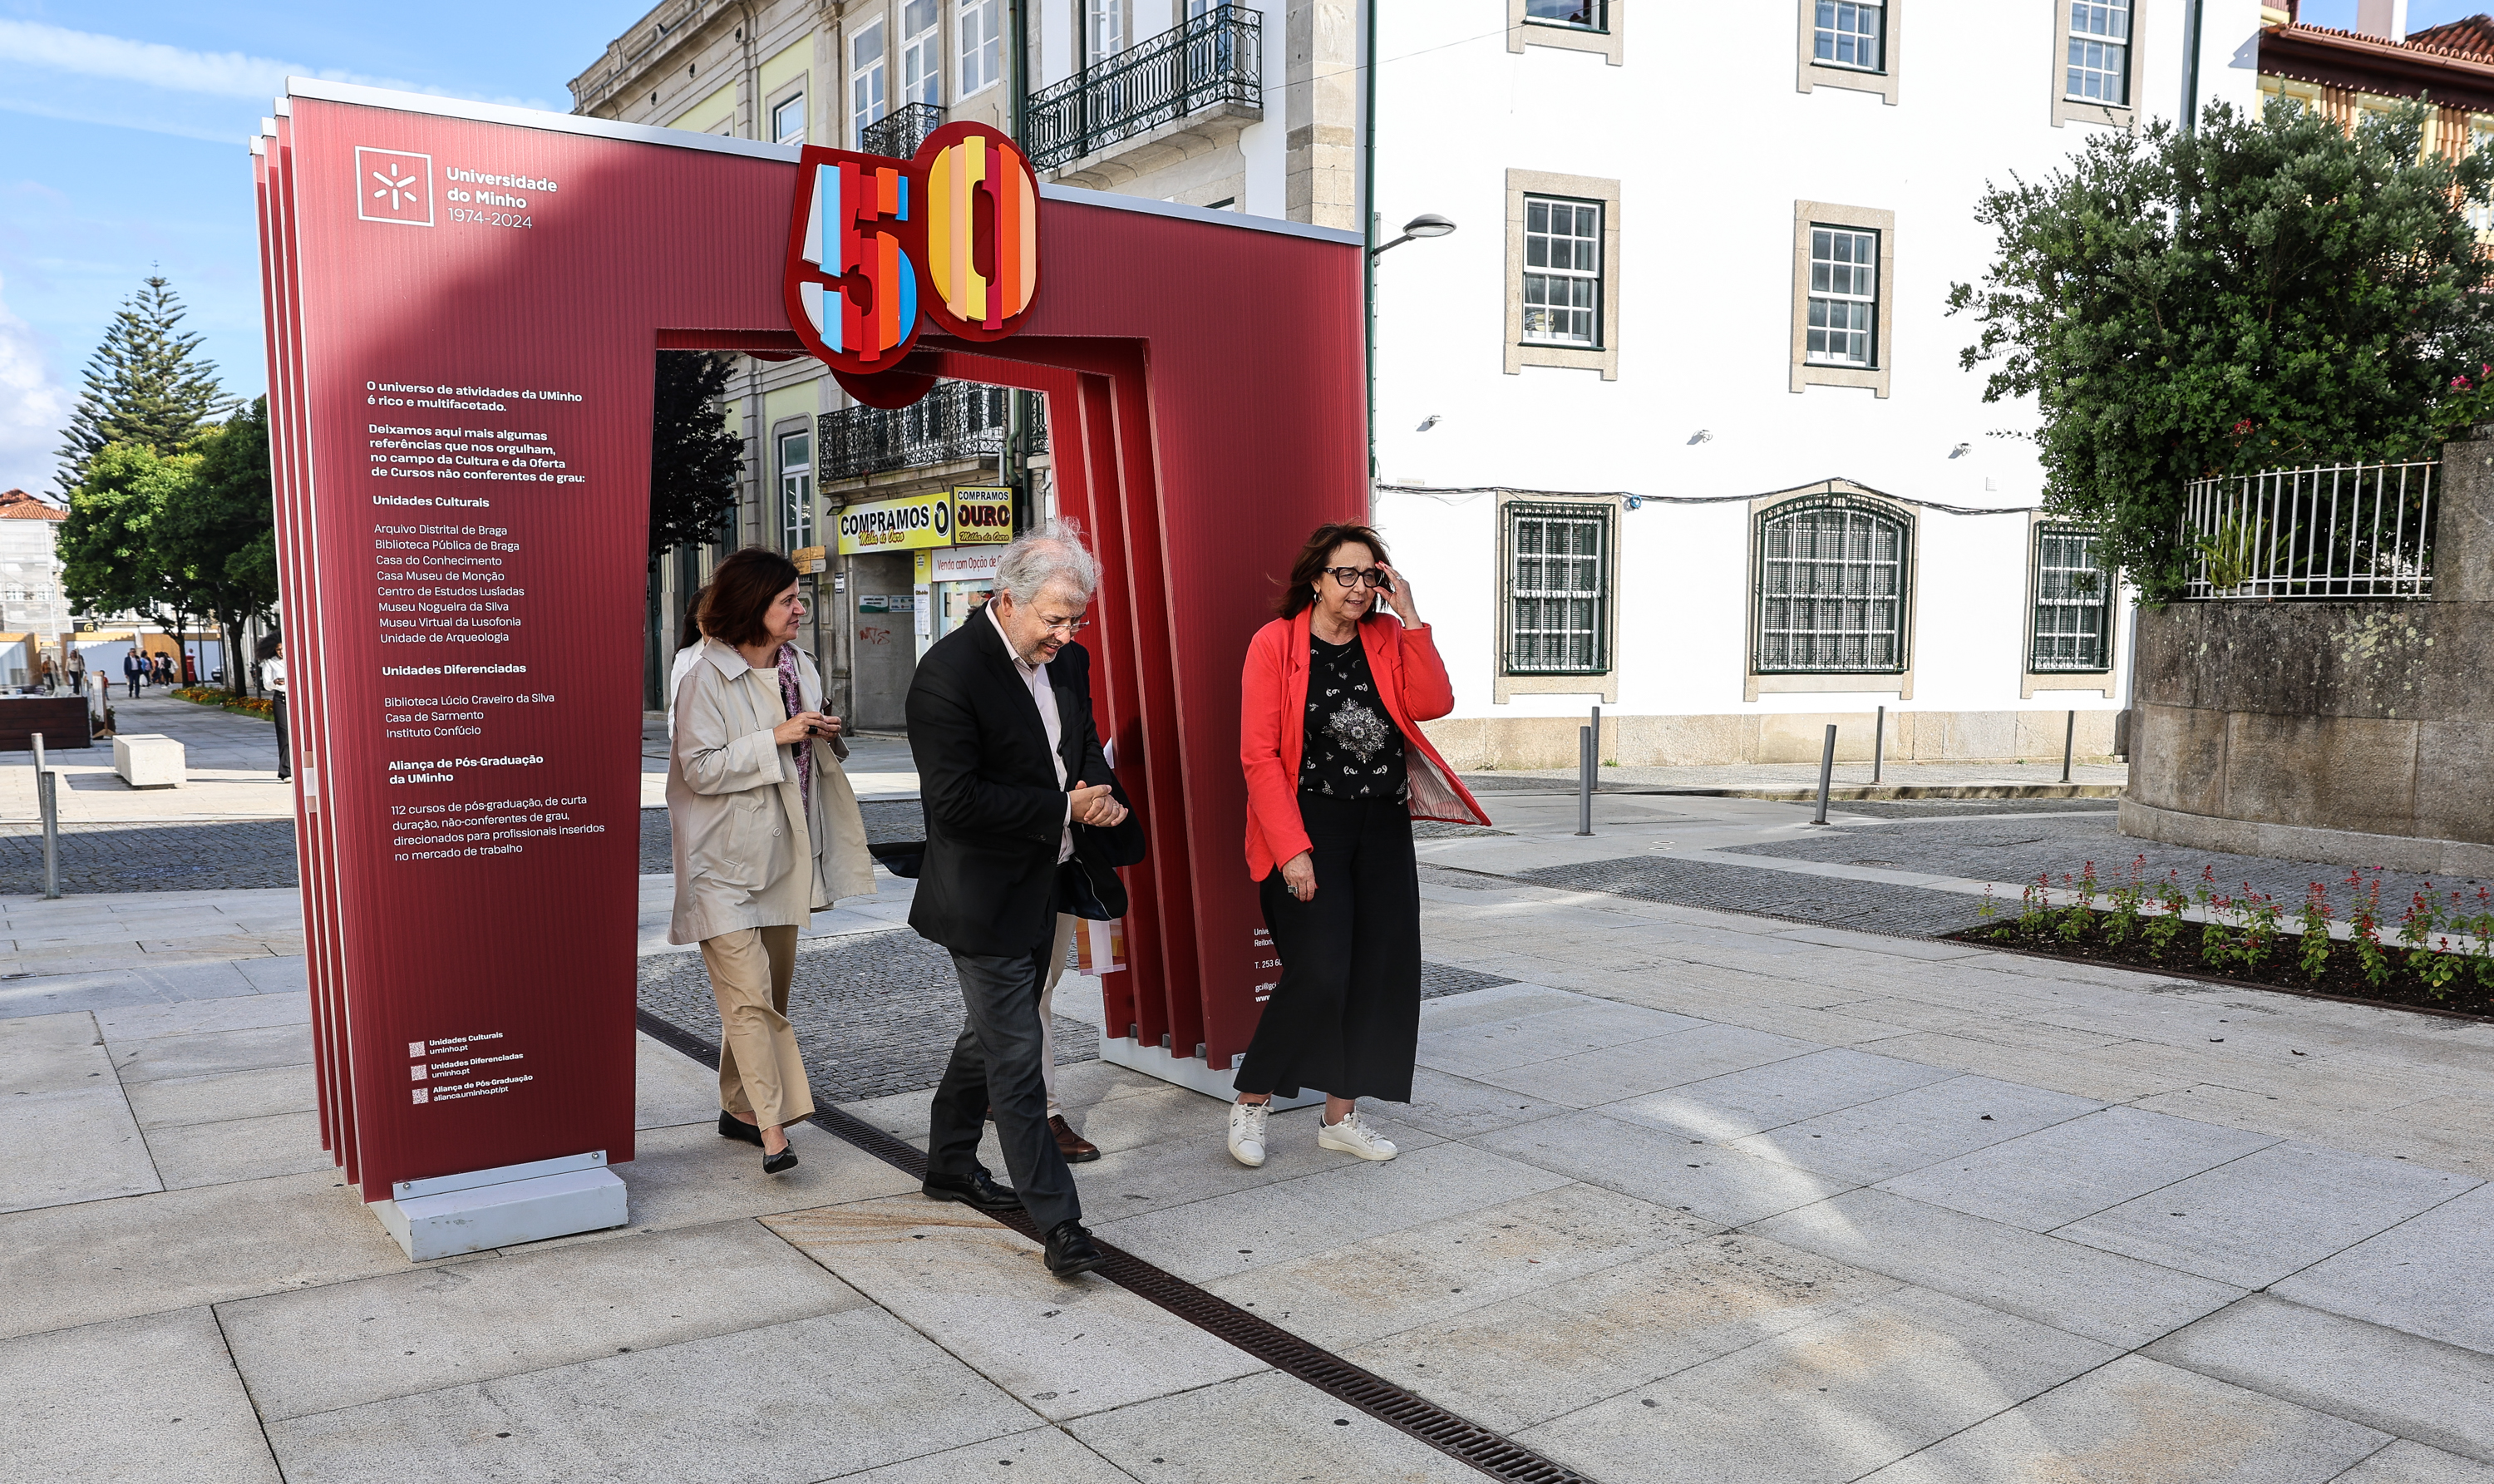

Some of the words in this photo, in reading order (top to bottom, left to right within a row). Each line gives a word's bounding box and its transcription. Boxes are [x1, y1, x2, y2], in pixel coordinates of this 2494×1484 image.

[446, 166, 557, 192] Universidade
[447, 187, 471, 202] do
[476, 190, 526, 208] Minho
[447, 208, 532, 229] 1974-2024
[800, 136, 1036, 362] 50
[367, 381, 376, 391] O
[379, 382, 434, 393] universo
[437, 384, 453, 394] de
[456, 386, 519, 398] atividades
[522, 389, 536, 399] da
[539, 391, 582, 402] UMinho
[367, 394, 376, 405] é
[378, 396, 403, 406] rico
[417, 398, 506, 412] multifacetado.
[369, 424, 432, 436] Deixamos
[435, 427, 461, 438] aqui
[464, 429, 494, 438] mais
[497, 429, 547, 441] algumas
[370, 438, 442, 450] referências
[445, 443, 468, 452] que
[471, 444, 494, 452] nos
[496, 444, 555, 456] orgulham,
[371, 454, 387, 462] no
[390, 455, 434, 466] campo
[437, 455, 452, 464] da
[456, 456, 499, 466] Cultura
[512, 457, 527, 467] da
[530, 458, 565, 468] Oferta
[371, 466, 387, 476] de
[391, 467, 435, 477] Cursos
[437, 469, 461, 479] não
[463, 470, 536, 481] conferentes
[539, 472, 554, 481] de
[557, 475, 585, 484] grau:
[372, 495, 432, 505] Unidades
[436, 497, 490, 507] Culturais
[958, 491, 1008, 500] COMPRAMOS
[841, 505, 929, 536] COMPRAMOS
[958, 505, 1010, 527] OURO
[374, 524, 416, 535] Arquivo
[419, 525, 459, 534] Distrital
[461, 525, 476, 535] de
[479, 525, 507, 537] Braga
[859, 530, 878, 546] Milha
[880, 535, 886, 544] de
[888, 527, 904, 543] Ouro
[959, 531, 981, 541] Milha
[983, 532, 992, 541] de
[993, 531, 1009, 541] Ouro
[376, 540, 429, 550] Biblioteca
[432, 540, 471, 550] Pública
[474, 540, 488, 550] de
[490, 541, 520, 552] Braga
[376, 555, 402, 565] Casa
[406, 555, 420, 565] do
[422, 555, 502, 565] Conhecimento
[938, 559, 954, 570] Venda
[956, 560, 967, 569] com
[969, 556, 988, 571] Opção
[989, 555, 996, 567] de
[377, 570, 403, 580] Casa
[406, 571, 442, 580] Museu
[446, 571, 459, 580] de
[462, 572, 505, 583] Monção
[377, 587, 414, 596] Centro
[417, 587, 431, 596] de
[435, 587, 477, 596] Estudos
[480, 586, 525, 596] Lusíadas
[379, 602, 416, 612] Museu
[418, 602, 466, 614] Nogueira
[469, 602, 482, 611] da
[485, 602, 509, 611] Silva
[380, 619, 416, 627] Museu
[418, 617, 452, 627] Virtual
[456, 617, 469, 627] da
[471, 617, 520, 627] Lusofonia
[381, 634, 426, 643] Unidade
[429, 633, 443, 642] de
[446, 632, 509, 643] Arqueologia
[382, 665, 441, 675] Unidades
[444, 663, 526, 674] Diferenciadas
[384, 697, 438, 707] Biblioteca
[441, 695, 469, 705] Lúcio
[471, 694, 514, 704] Craveiro
[516, 693, 529, 703] da
[532, 693, 554, 703] Silva
[386, 713, 412, 723] Casa
[414, 712, 429, 722] de
[431, 712, 484, 721] Sarmento
[387, 728, 431, 738] Instituto
[434, 725, 481, 737] Confúcio
[388, 760, 434, 772] Aliança
[437, 758, 452, 768] de
[456, 755, 544, 767] Pós-Graduação
[389, 775, 405, 784] da
[407, 772, 454, 783] UMinho
[391, 806, 406, 815] 112
[409, 805, 446, 814] cursos
[448, 802, 462, 811] de
[465, 798, 543, 812] pós-graduação,
[545, 796, 559, 806] de
[561, 796, 587, 805] curta
[392, 820, 439, 831] duração,
[441, 815, 527, 827] não-conferentes
[530, 812, 543, 821] de
[545, 813, 569, 823] grau,
[394, 833, 464, 846] direcionados
[467, 832, 490, 843] para
[493, 826, 557, 841] profissionais
[559, 824, 605, 835] inseridos
[395, 853, 409, 861] no
[412, 848, 461, 860] mercado
[464, 846, 477, 856] de
[480, 844, 522, 855] trabalho
[1254, 961, 1261, 969] T.
[1262, 959, 1274, 969] 253
[429, 1037, 467, 1046] Unidades
[468, 1032, 503, 1041] Culturais
[429, 1045, 469, 1055] uminho.pt
[431, 1061, 469, 1070] Unidades
[470, 1053, 524, 1065] Diferenciadas
[431, 1068, 471, 1079] uminho.pt
[433, 1085, 462, 1093] Aliança
[476, 1074, 533, 1087] Pós-Graduação
[434, 1086, 509, 1102] alianca.uminho.pt/pt
